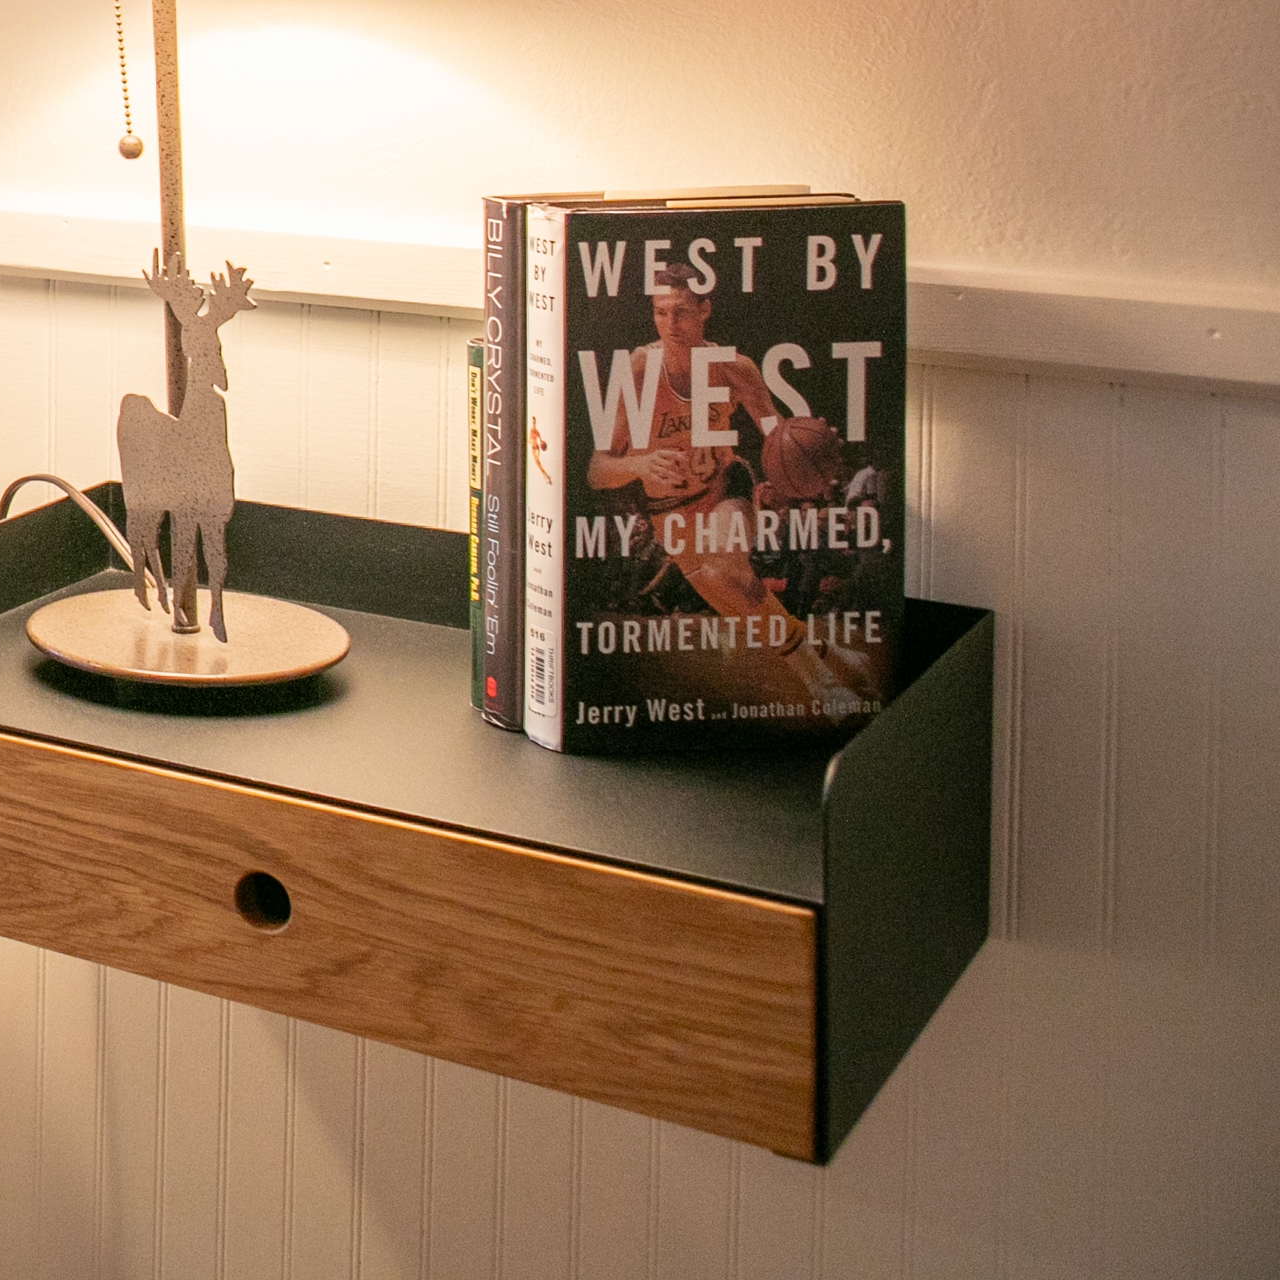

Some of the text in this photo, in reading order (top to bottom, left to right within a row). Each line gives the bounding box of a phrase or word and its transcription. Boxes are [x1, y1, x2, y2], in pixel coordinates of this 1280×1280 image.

[528, 235, 556, 256] WEST
[534, 264, 546, 283] BY
[578, 233, 883, 297] WEST BY
[528, 289, 556, 312] WEST
[577, 341, 883, 451] WEST
[485, 218, 503, 655] BILLY CRYSTAL Still Foolin' 'Em
[527, 533, 553, 558] West
[575, 506, 892, 559] MY CHARMED,
[529, 628, 546, 642] 516
[576, 610, 882, 655] TORMENTED LIFE
[575, 700, 638, 728] Jerry
[646, 698, 706, 722] West
[710, 711, 727, 720] and
[731, 701, 805, 719] Jonathan
